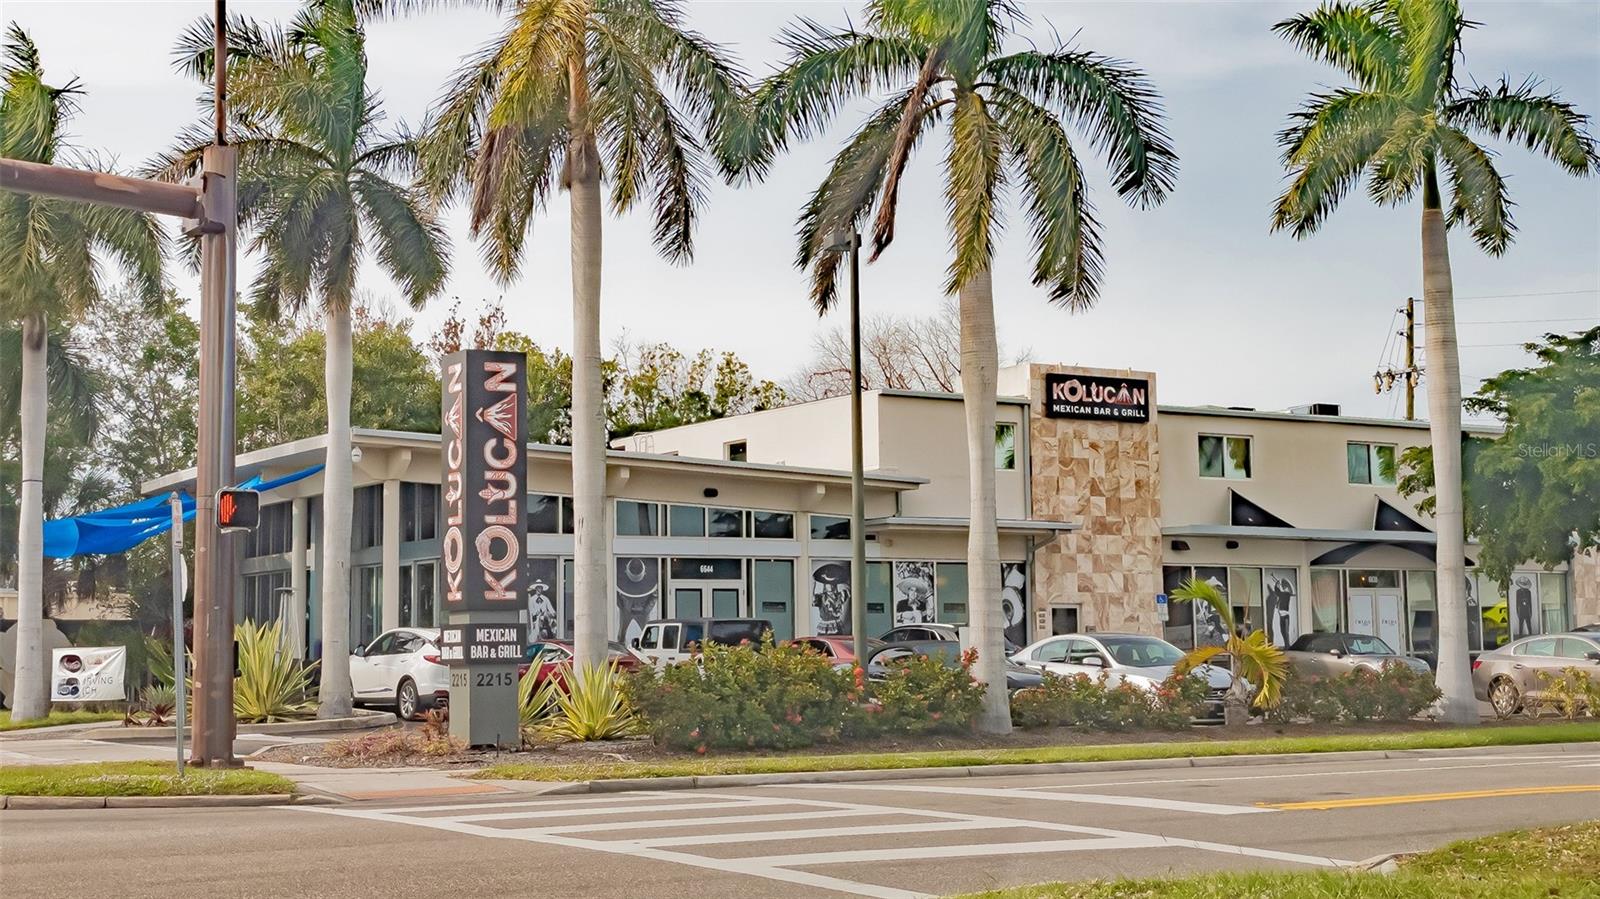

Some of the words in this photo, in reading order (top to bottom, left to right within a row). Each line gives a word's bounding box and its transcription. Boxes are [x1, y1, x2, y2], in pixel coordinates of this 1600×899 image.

[1053, 404, 1091, 414] MEXICAN
[1094, 407, 1111, 416] BAR
[1121, 408, 1145, 417] GRILL
[476, 628, 517, 642] MEXICAN
[470, 645, 489, 659] BAR
[490, 647, 497, 659] &
[498, 644, 522, 658] GRILL
[452, 673, 468, 687] 2215
[476, 672, 512, 687] 2215
